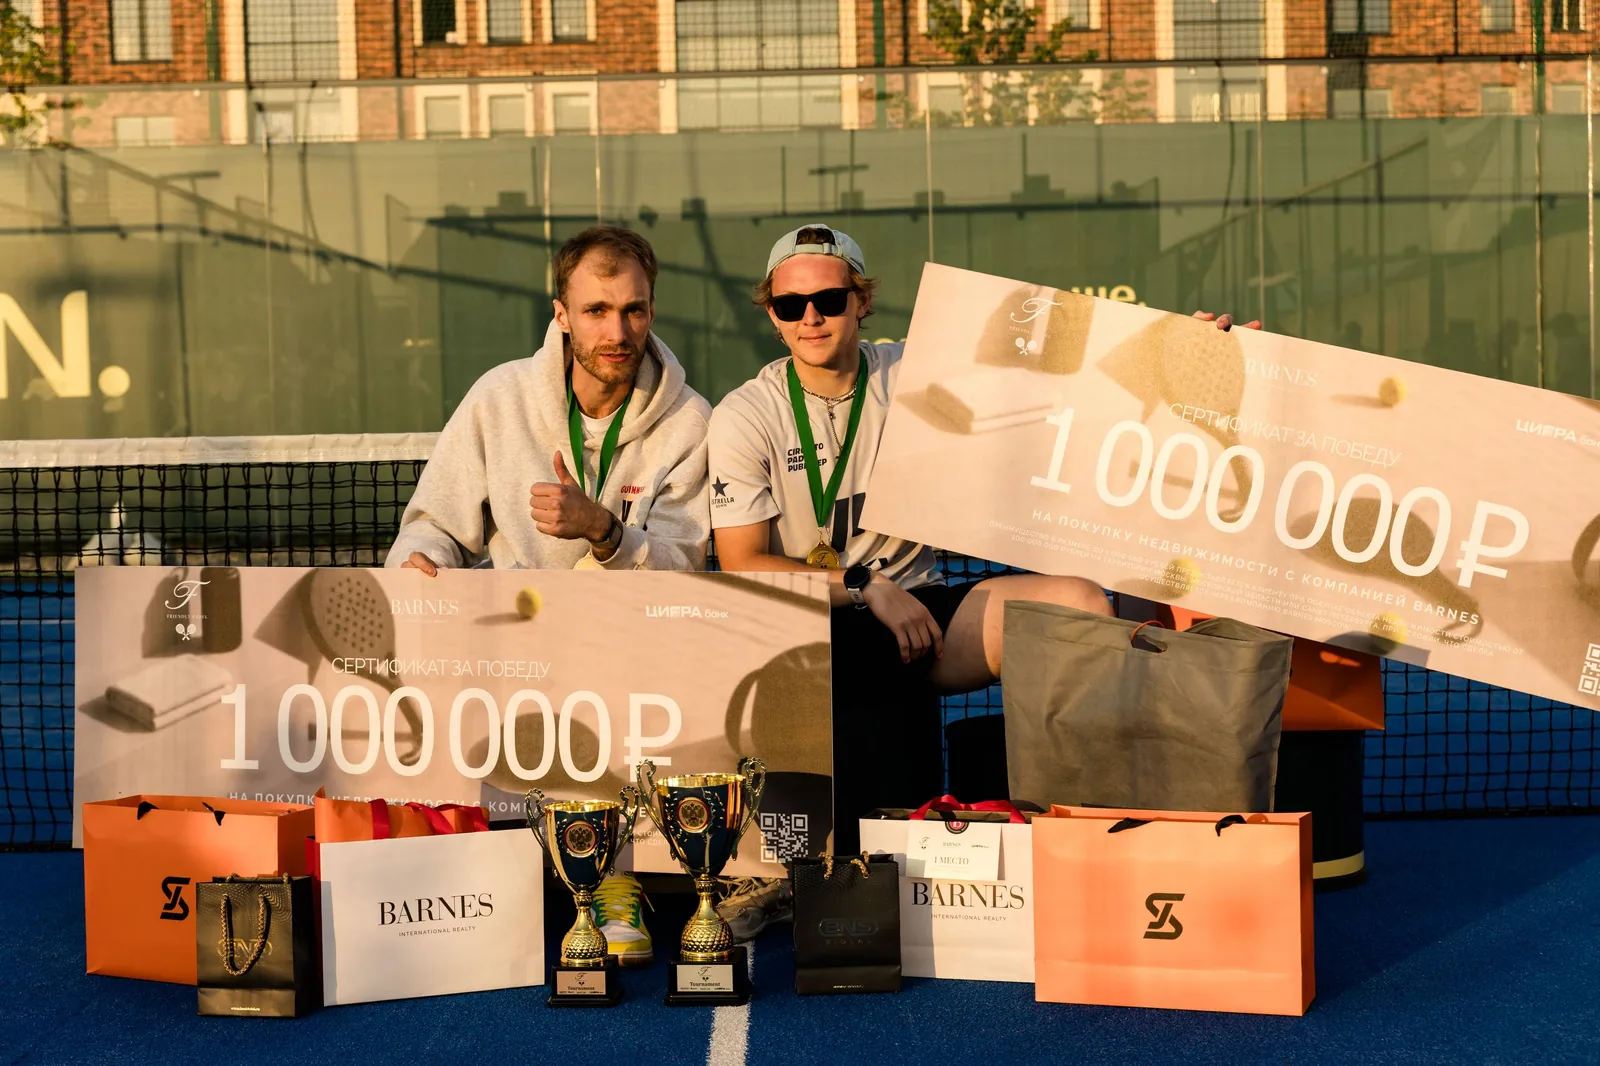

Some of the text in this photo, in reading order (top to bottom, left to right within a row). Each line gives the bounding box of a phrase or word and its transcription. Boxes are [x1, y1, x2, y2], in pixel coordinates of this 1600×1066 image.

[1169, 402, 1402, 471] СЕРТИФИКАТ ЗА ПОБЕДУ
[1030, 407, 1076, 494] 1
[1096, 420, 1265, 533] 000
[1274, 460, 1452, 577] 000
[1032, 510, 1479, 623] НА ПОКУПКУ НЕДВИЖИМОСТИ С КОМПАНИЕЙ BARNES
[390, 599, 459, 616] BARNES
[704, 608, 729, 619] банк
[331, 656, 551, 682] СЕРТИФИКАТ ЗА ПОБЕДУ
[220, 684, 259, 770] 1
[278, 684, 434, 777] 000
[449, 687, 612, 782] 000
[377, 893, 494, 926] BARNES
[911, 881, 1025, 910] BARNES
[398, 928, 451, 938] INTERNATIONAL
